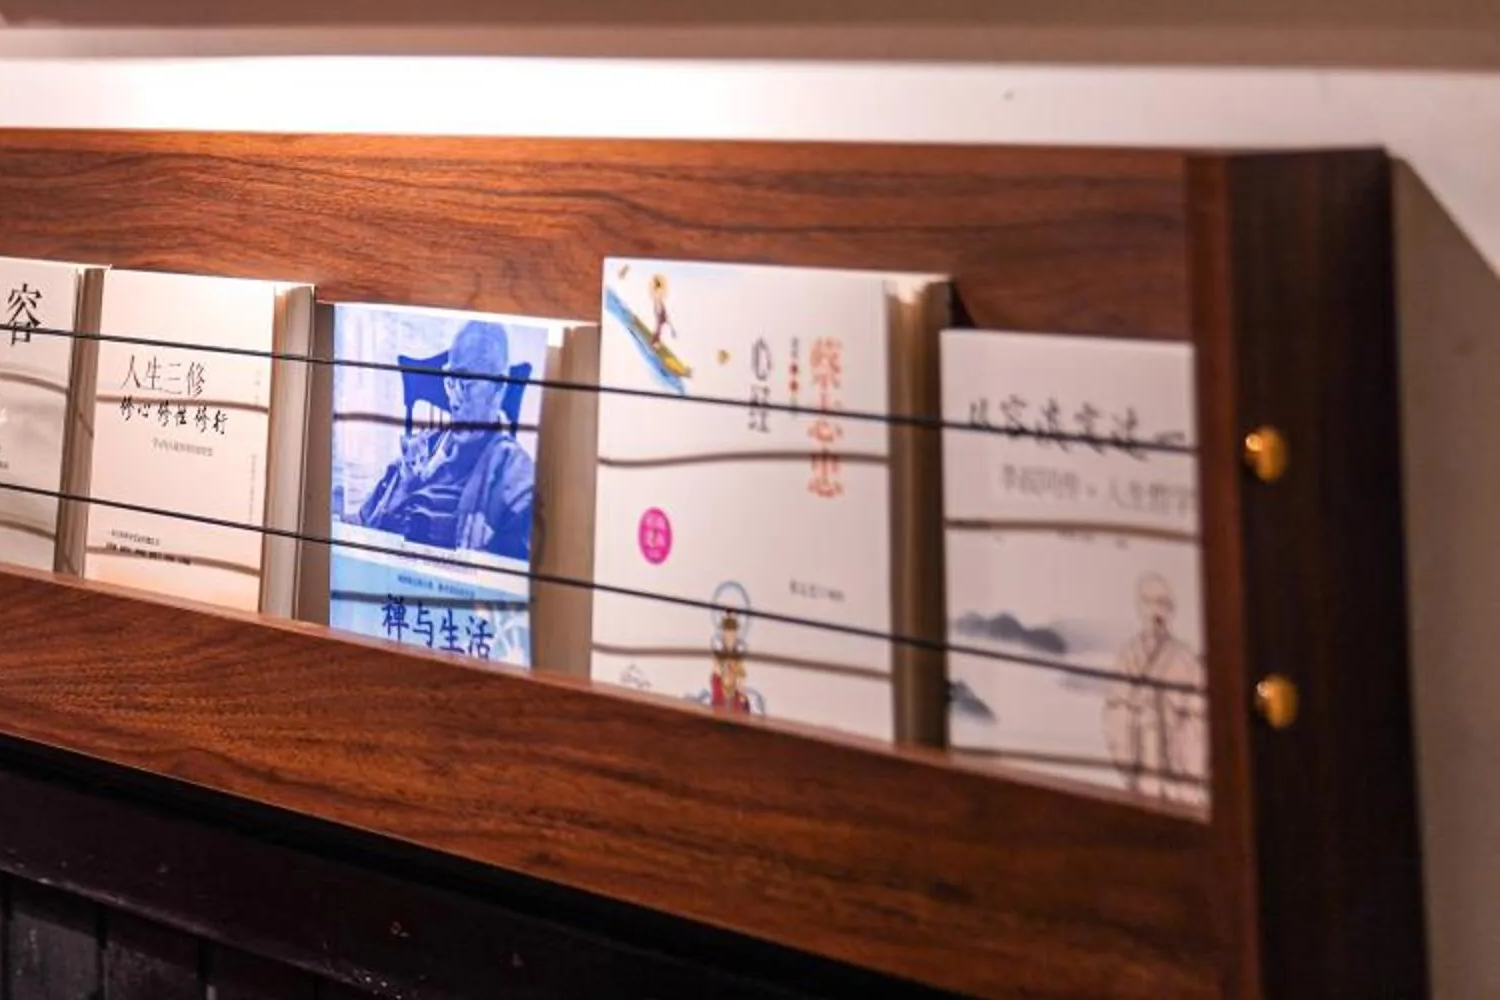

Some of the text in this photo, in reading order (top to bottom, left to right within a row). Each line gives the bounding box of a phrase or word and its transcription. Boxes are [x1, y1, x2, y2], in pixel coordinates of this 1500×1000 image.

[119, 353, 207, 398] 人生三修
[381, 593, 494, 659] 禅与生活
